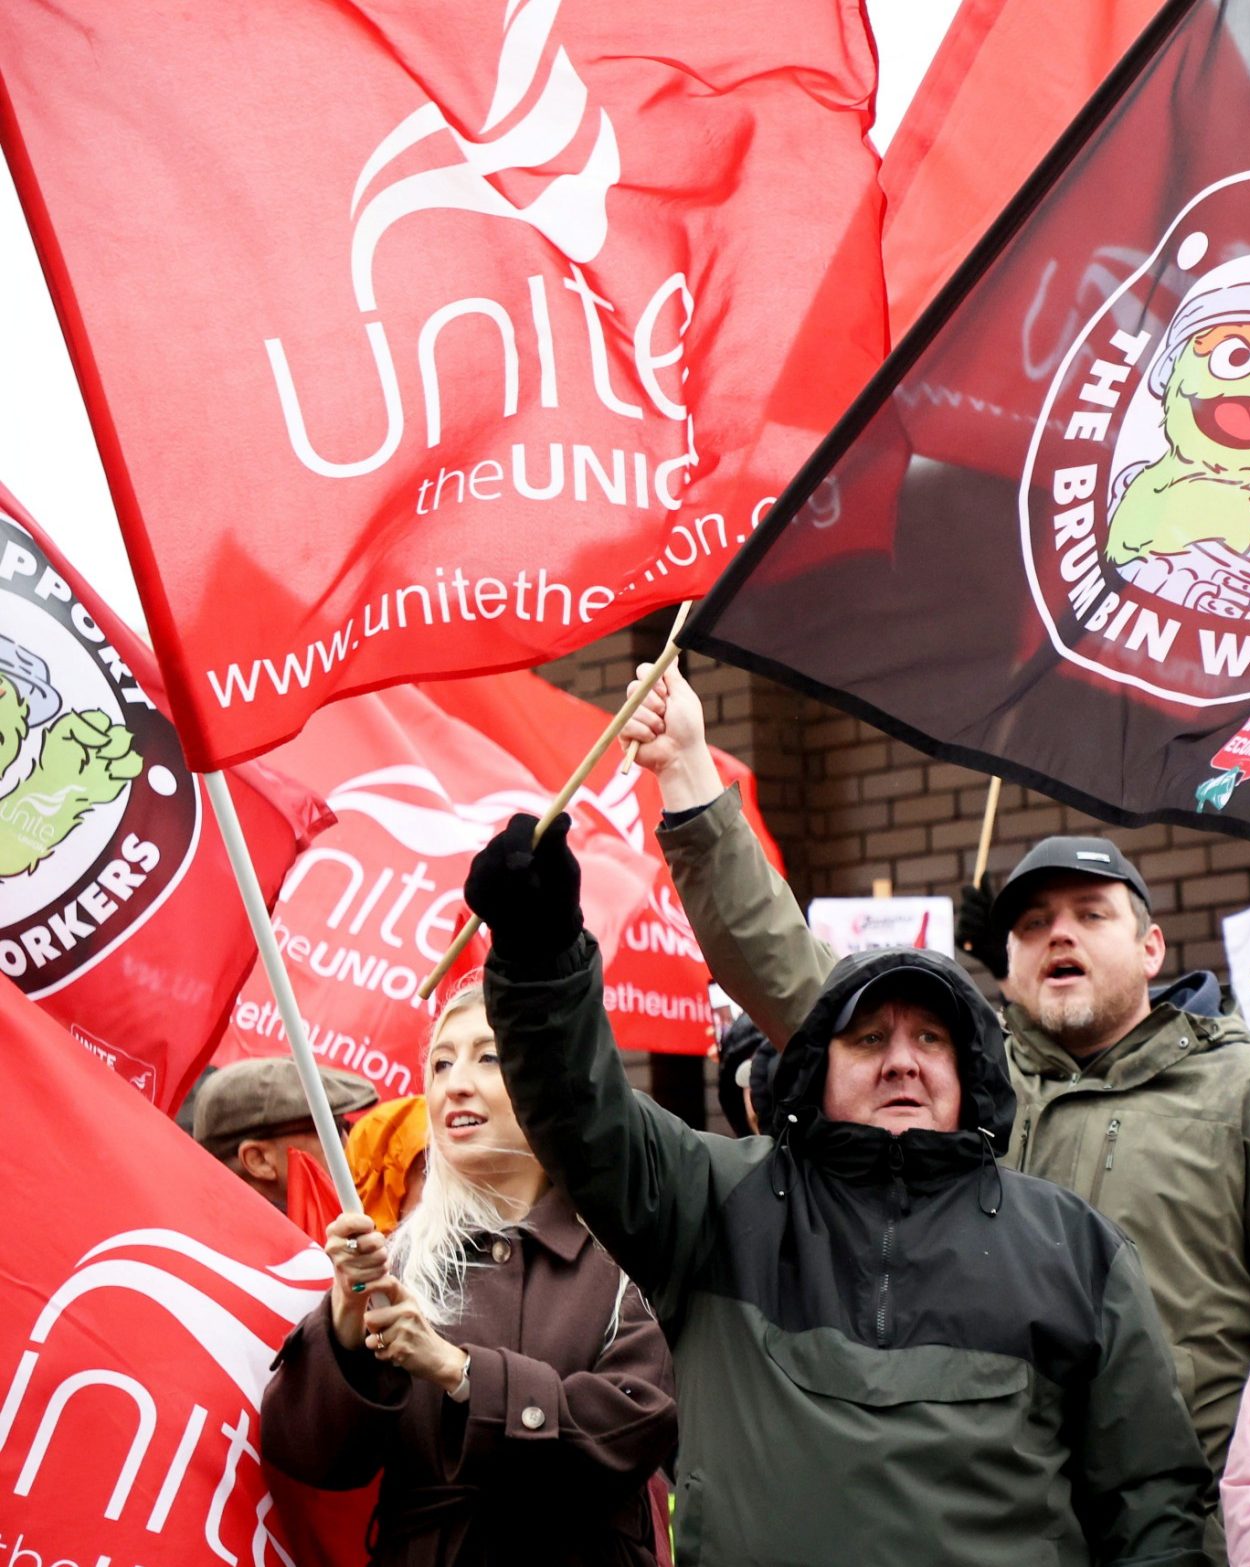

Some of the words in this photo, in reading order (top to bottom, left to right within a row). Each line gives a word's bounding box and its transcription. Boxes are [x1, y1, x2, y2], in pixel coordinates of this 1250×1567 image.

[1063, 329, 1151, 443] THE
[1084, 591, 1182, 663] BIN
[0, 833, 160, 977] ORKERS
[281, 848, 478, 964] nite
[271, 916, 437, 1016] heUNION
